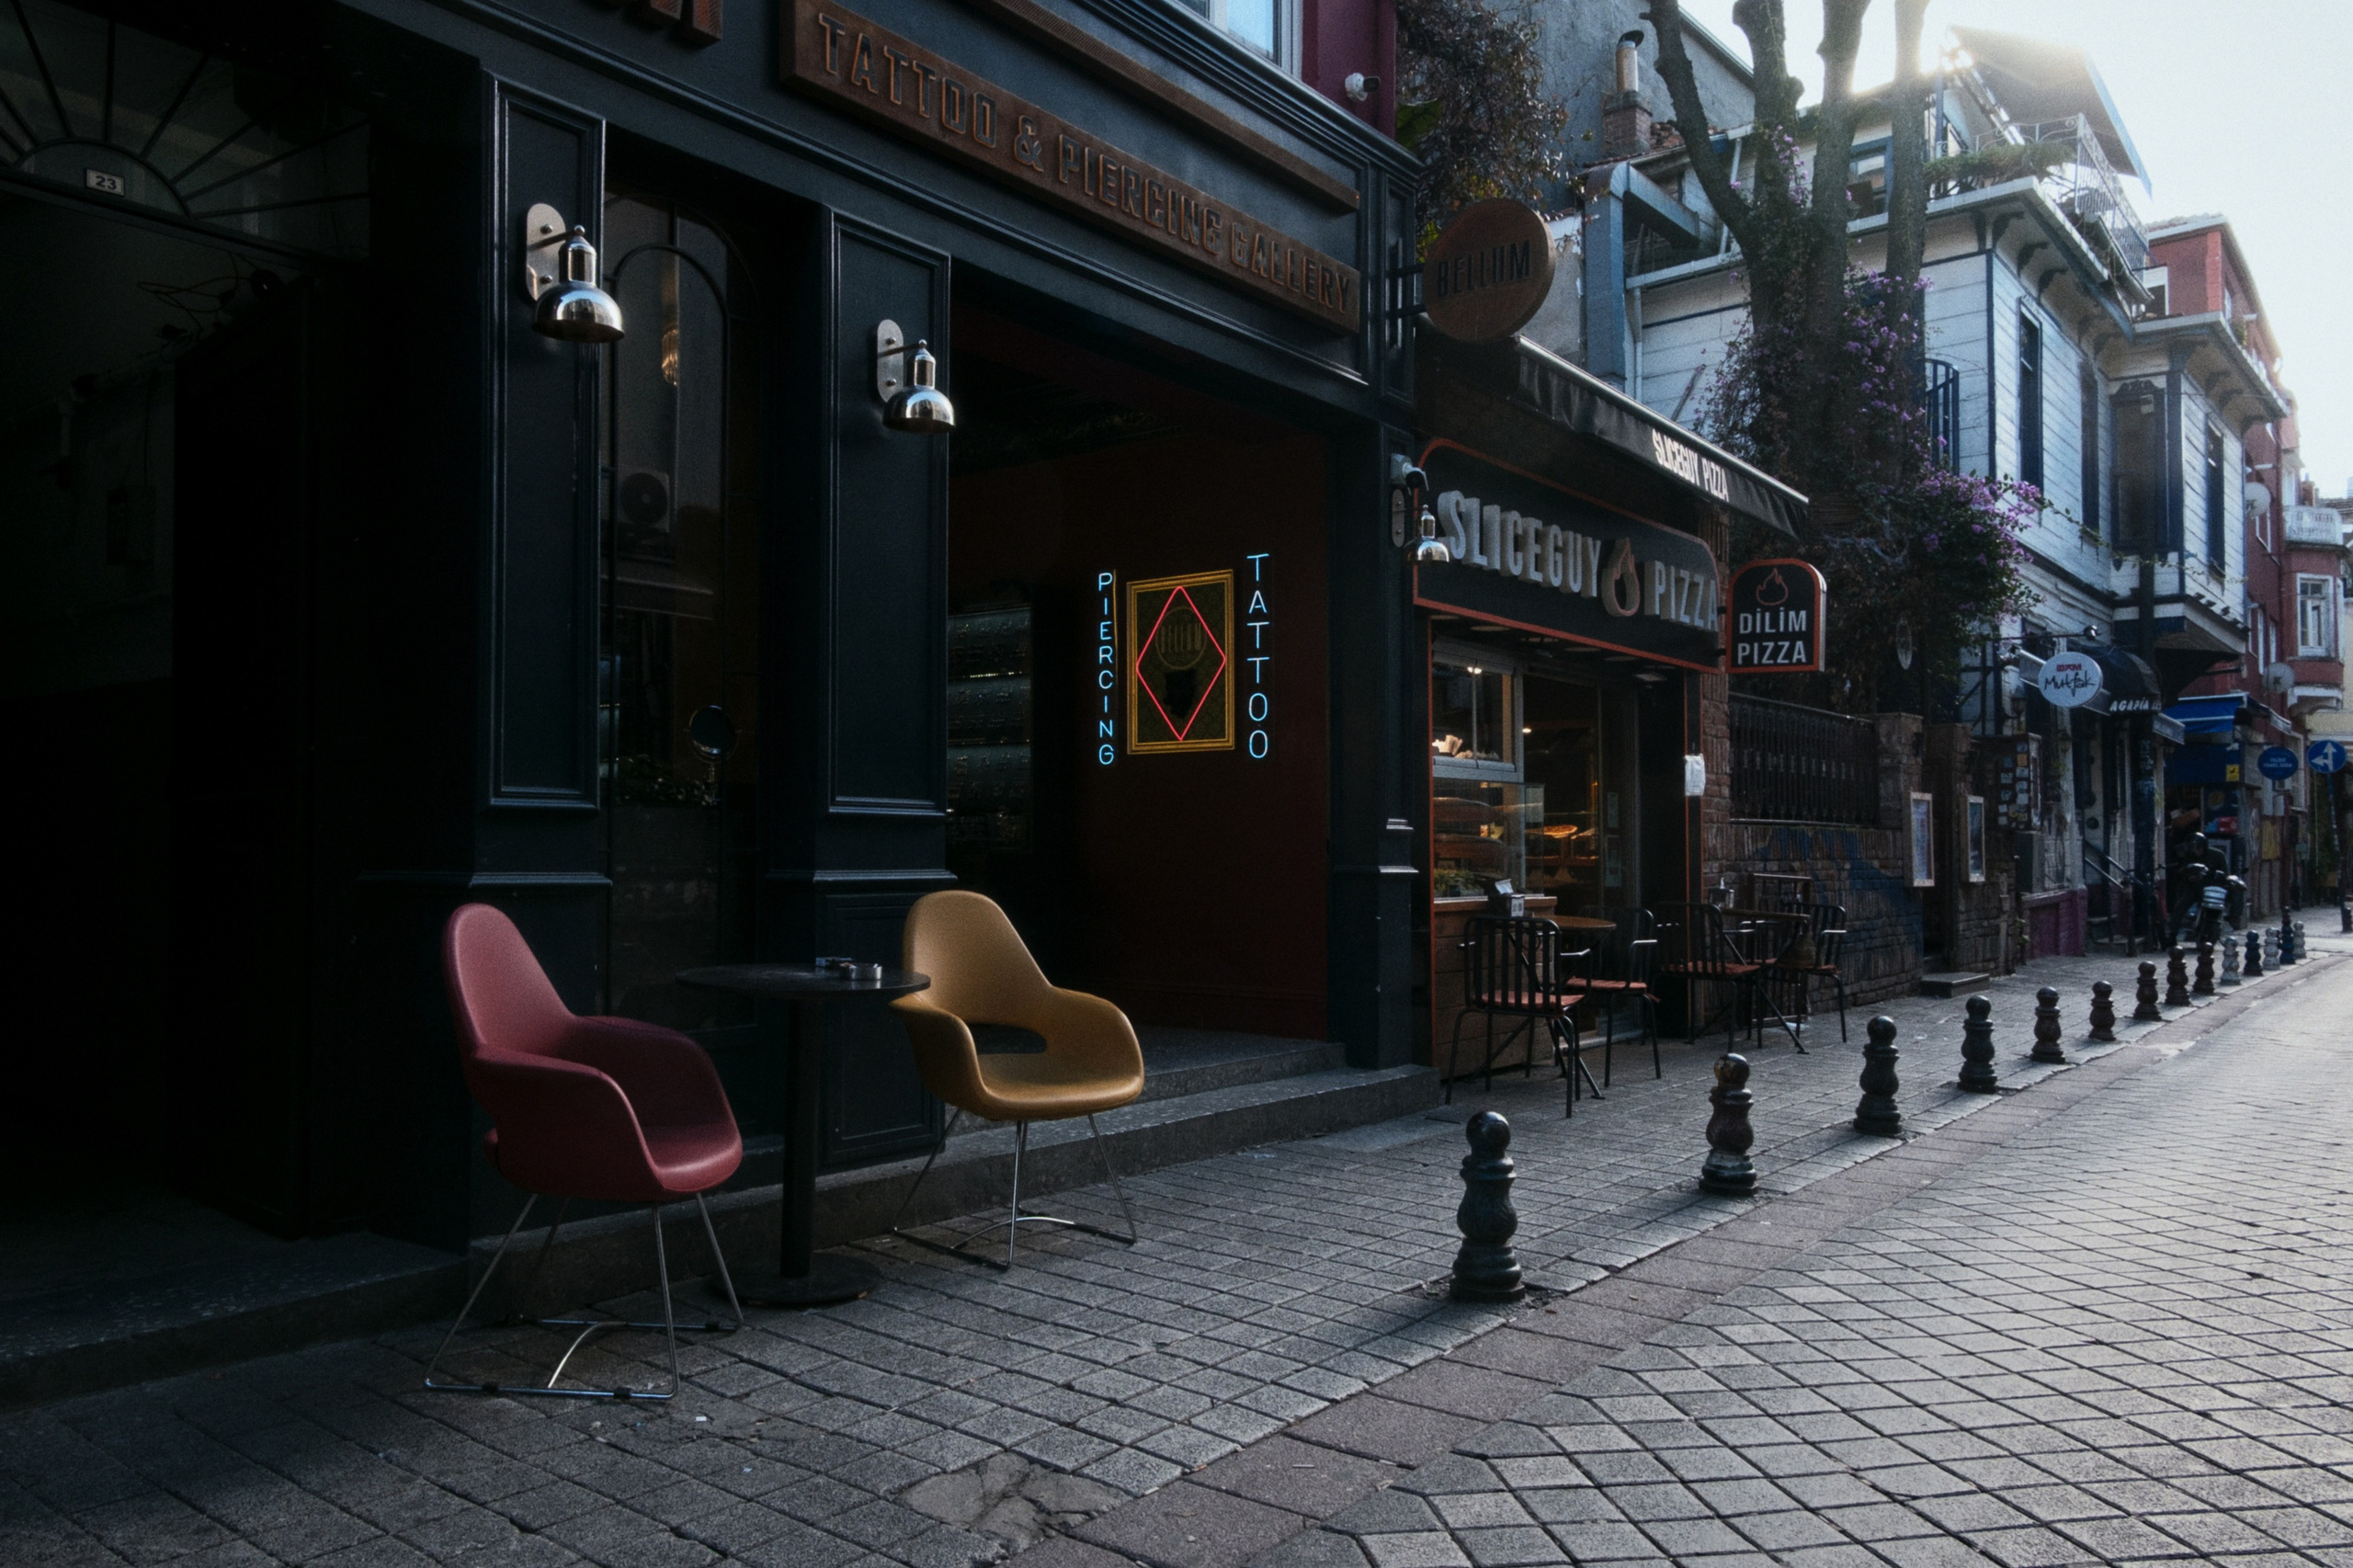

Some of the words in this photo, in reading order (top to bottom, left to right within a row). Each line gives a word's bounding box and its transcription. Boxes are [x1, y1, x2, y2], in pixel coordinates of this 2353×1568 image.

[95, 175, 118, 190] 23
[818, 12, 997, 149] TATTOO
[1013, 115, 1045, 173] &
[1058, 133, 1222, 256] PIERCING
[1231, 221, 1350, 315] GALLERY
[1652, 427, 1701, 487] SLICEGUY
[1701, 456, 1730, 504] PIZZA
[1438, 490, 1602, 597] SLICEGUY
[1645, 560, 1720, 632] PIZZA
[1097, 572, 1115, 766] PIERCING
[1246, 553, 1270, 759] TATTOO
[1737, 641, 1807, 665] PIZZA
[1739, 607, 1807, 634] DİLİM
